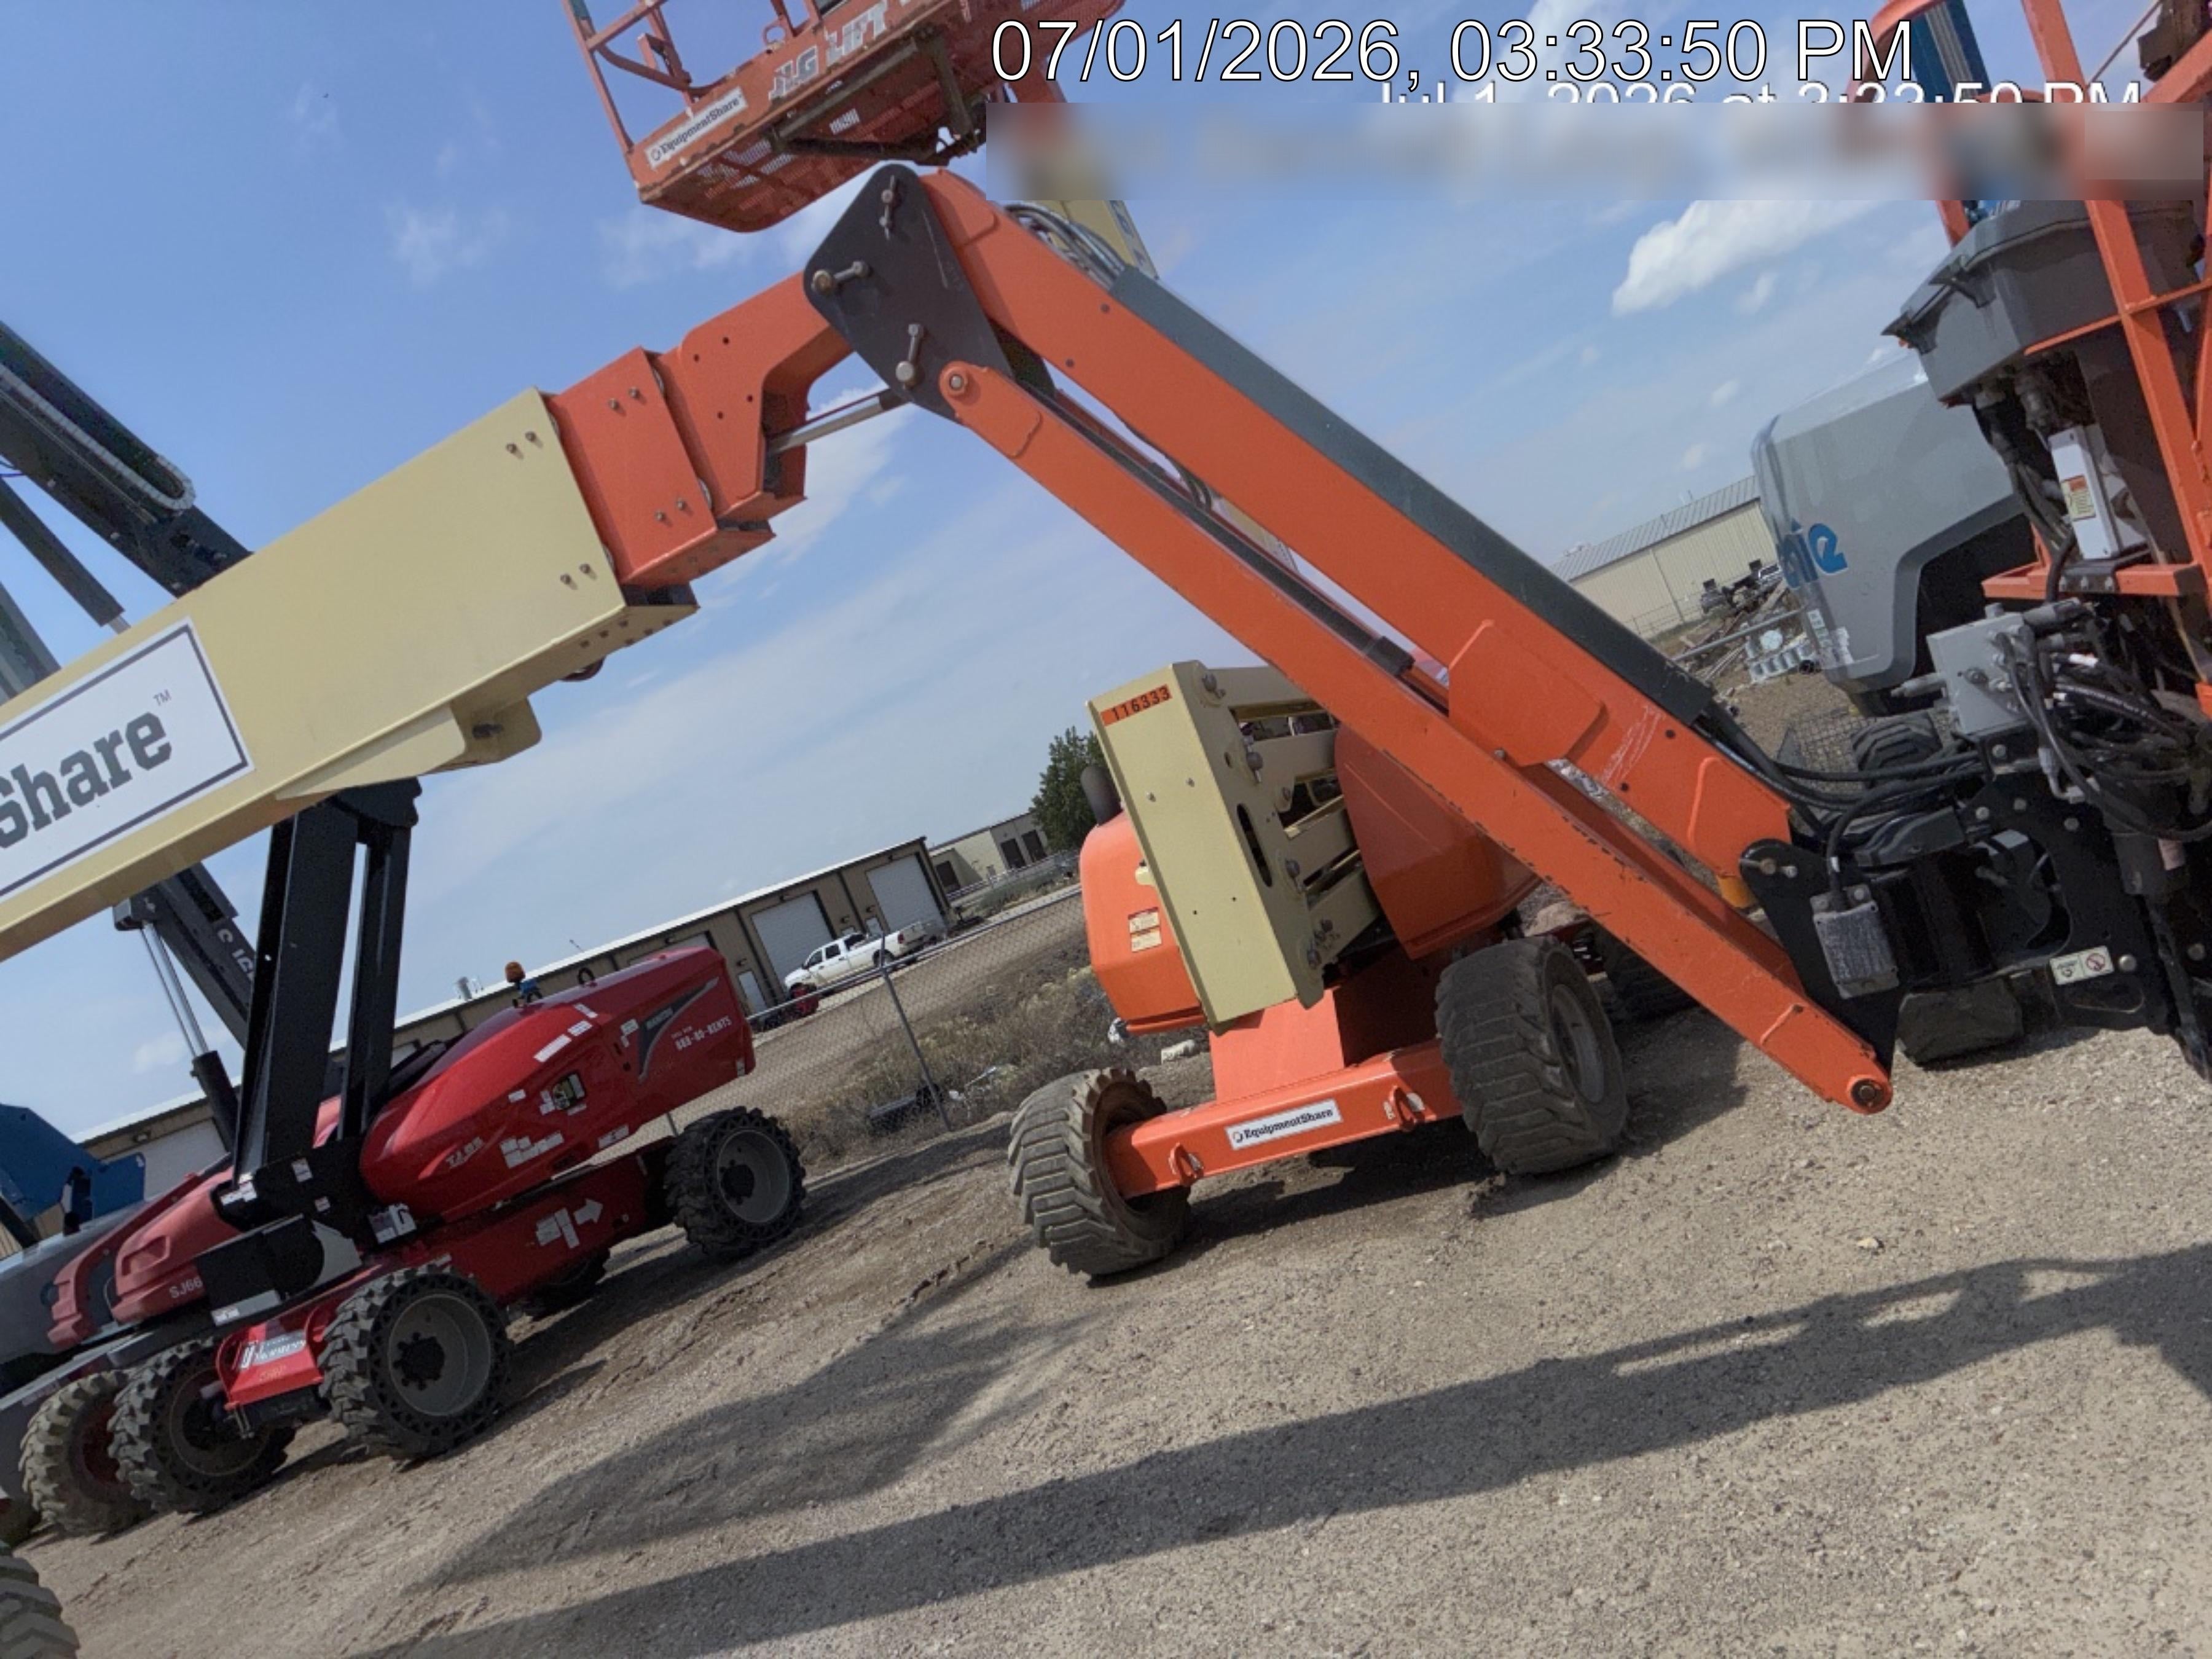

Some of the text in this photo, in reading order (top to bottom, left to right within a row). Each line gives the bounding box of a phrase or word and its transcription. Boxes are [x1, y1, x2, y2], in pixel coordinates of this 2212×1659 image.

[660, 98, 740, 155] EquipmentShare
[1111, 685, 1171, 721] 116333
[1243, 1108, 1334, 1140] EquipmentShare
